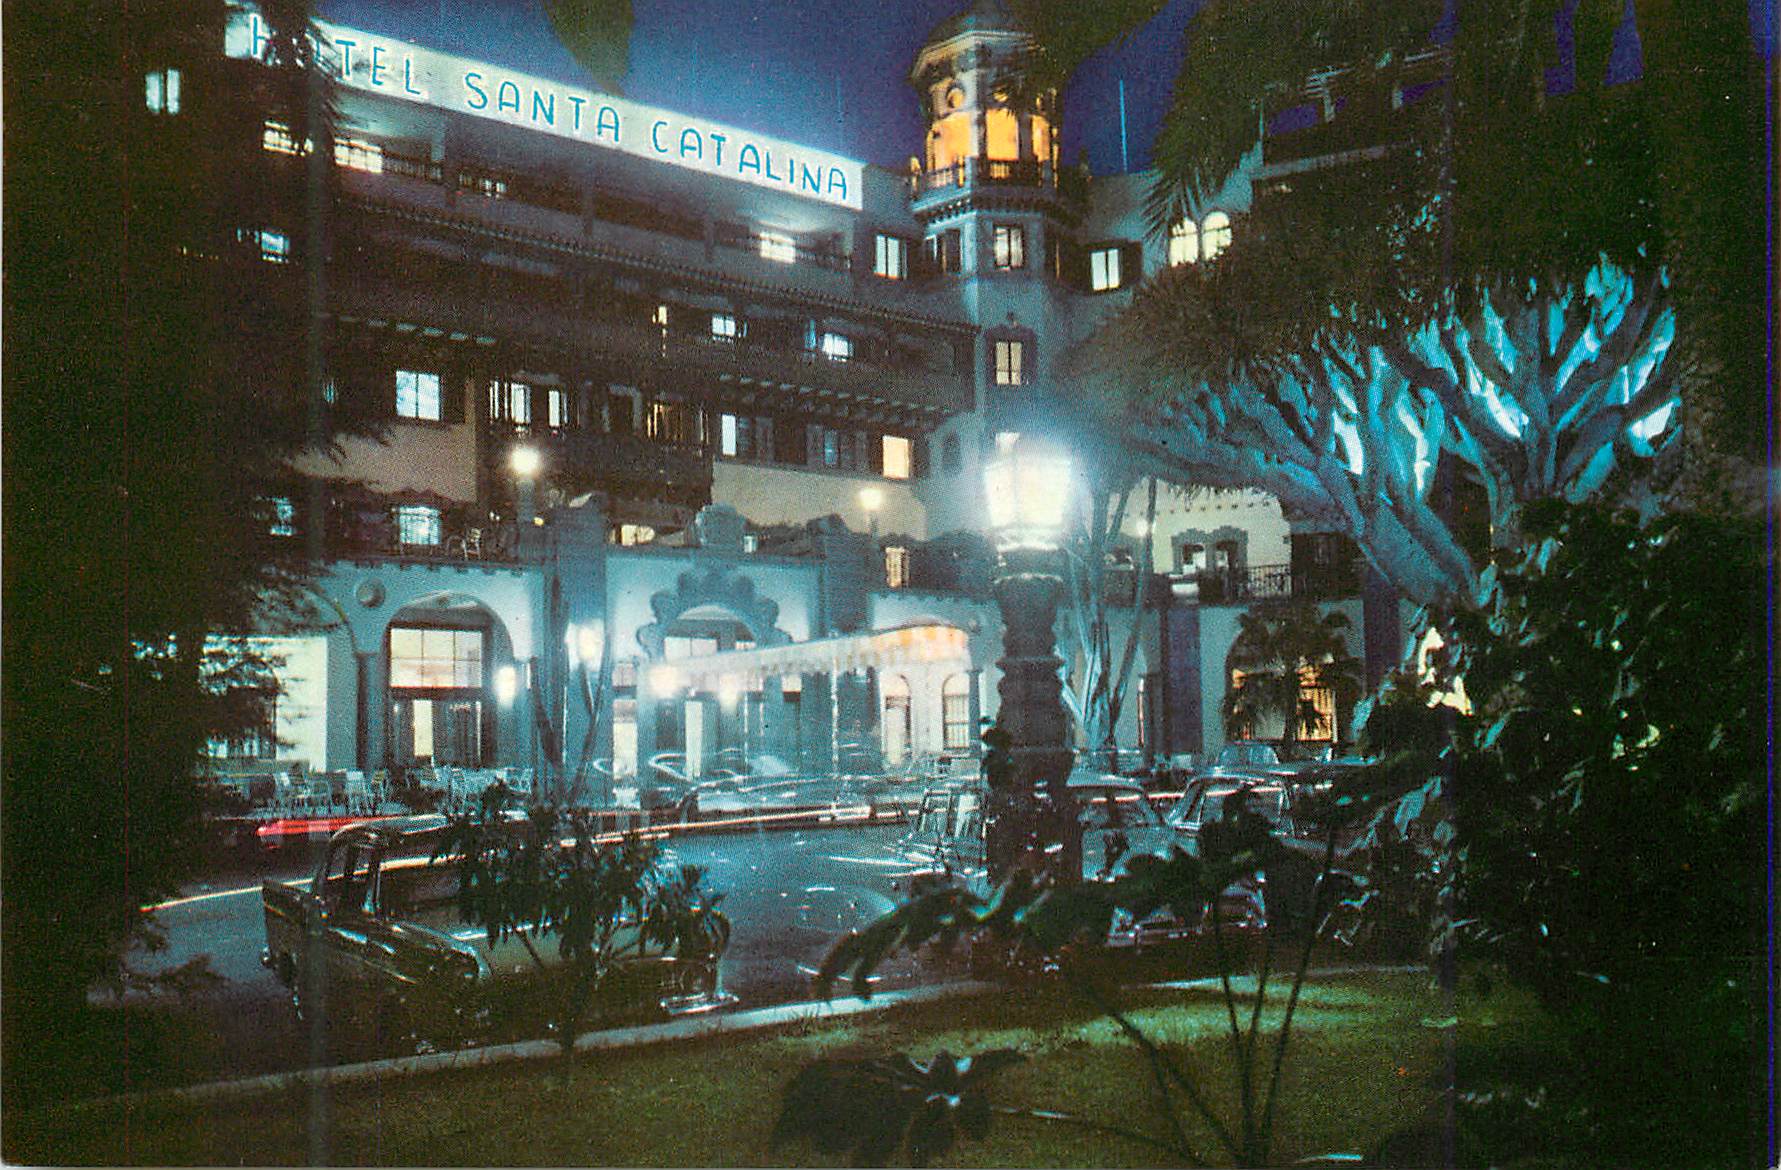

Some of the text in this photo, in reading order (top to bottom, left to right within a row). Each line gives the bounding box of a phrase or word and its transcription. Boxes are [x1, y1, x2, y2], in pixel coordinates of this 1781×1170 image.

[252, 15, 848, 200] HTEL SANTA CATALINA
